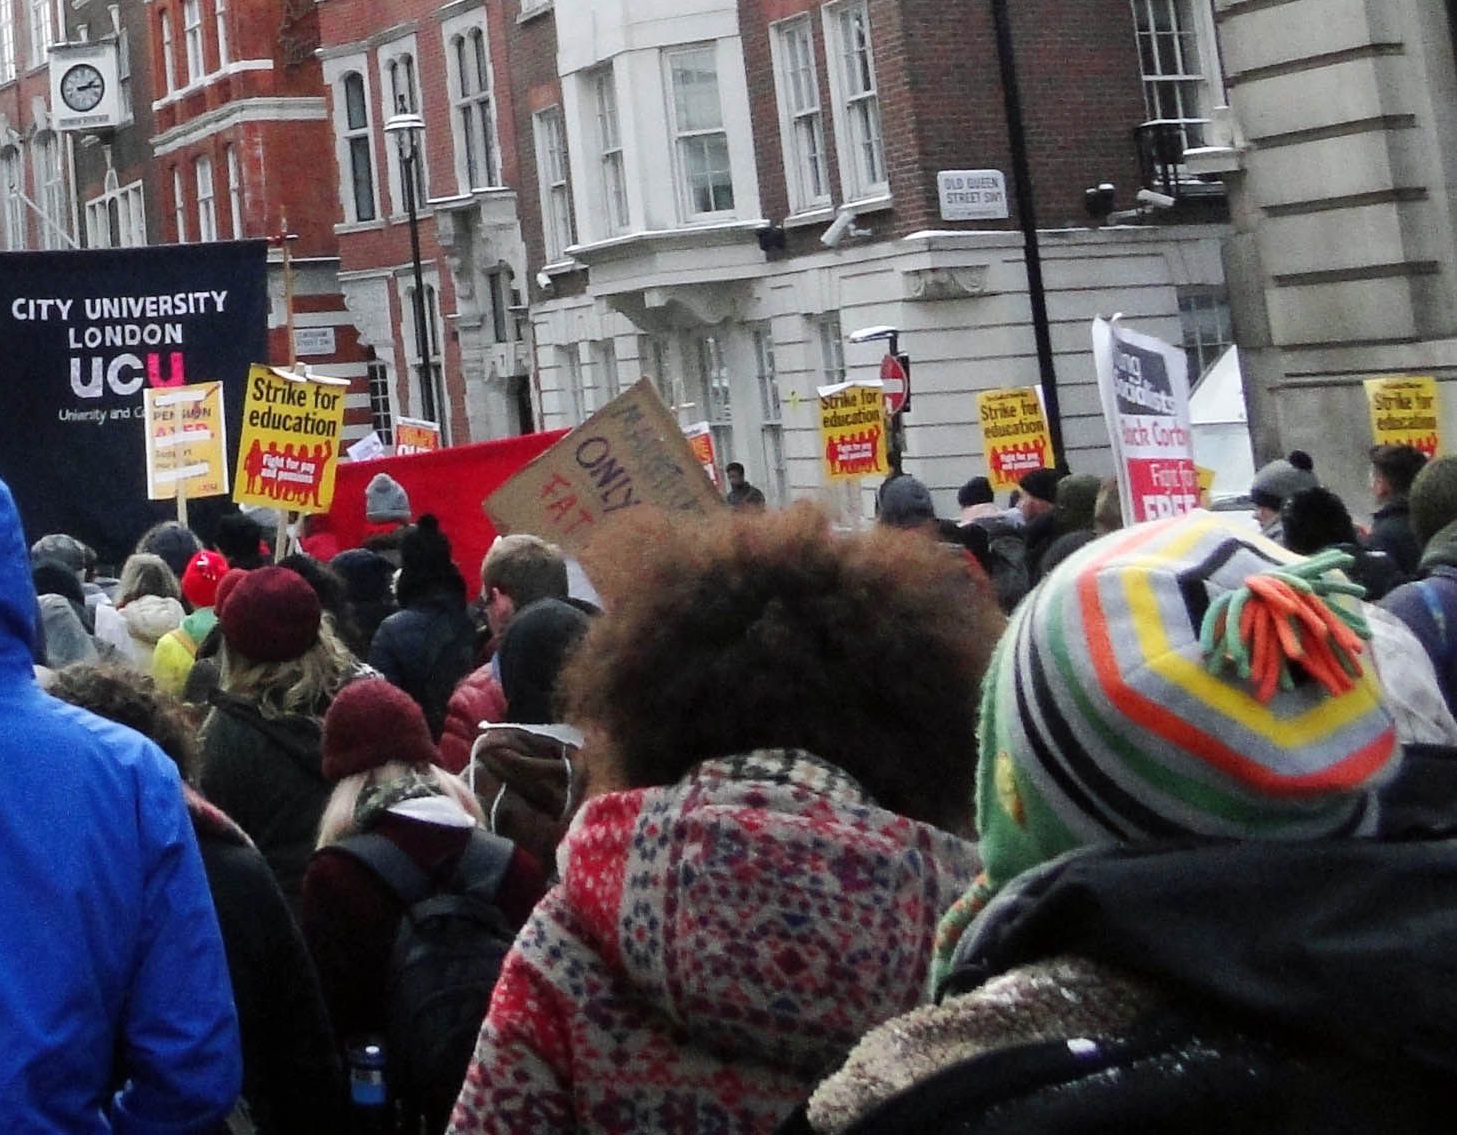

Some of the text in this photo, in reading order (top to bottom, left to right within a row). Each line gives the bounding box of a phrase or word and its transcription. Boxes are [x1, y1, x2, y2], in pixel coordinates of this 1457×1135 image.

[944, 177, 999, 190] OLD QUEEN
[946, 192, 980, 204] STREET
[11, 291, 228, 320] CITY UNIVERSITY
[69, 324, 183, 349] LONDON
[70, 352, 185, 398] UCU
[253, 377, 340, 411] Strike for
[860, 389, 877, 405] for
[59, 408, 106, 425] University
[110, 406, 130, 419] and
[249, 406, 337, 437] education
[823, 407, 880, 427] education
[981, 402, 1016, 421] Strike
[984, 417, 1044, 438] education
[576, 436, 641, 512] ONLY
[541, 472, 594, 534] FAT
